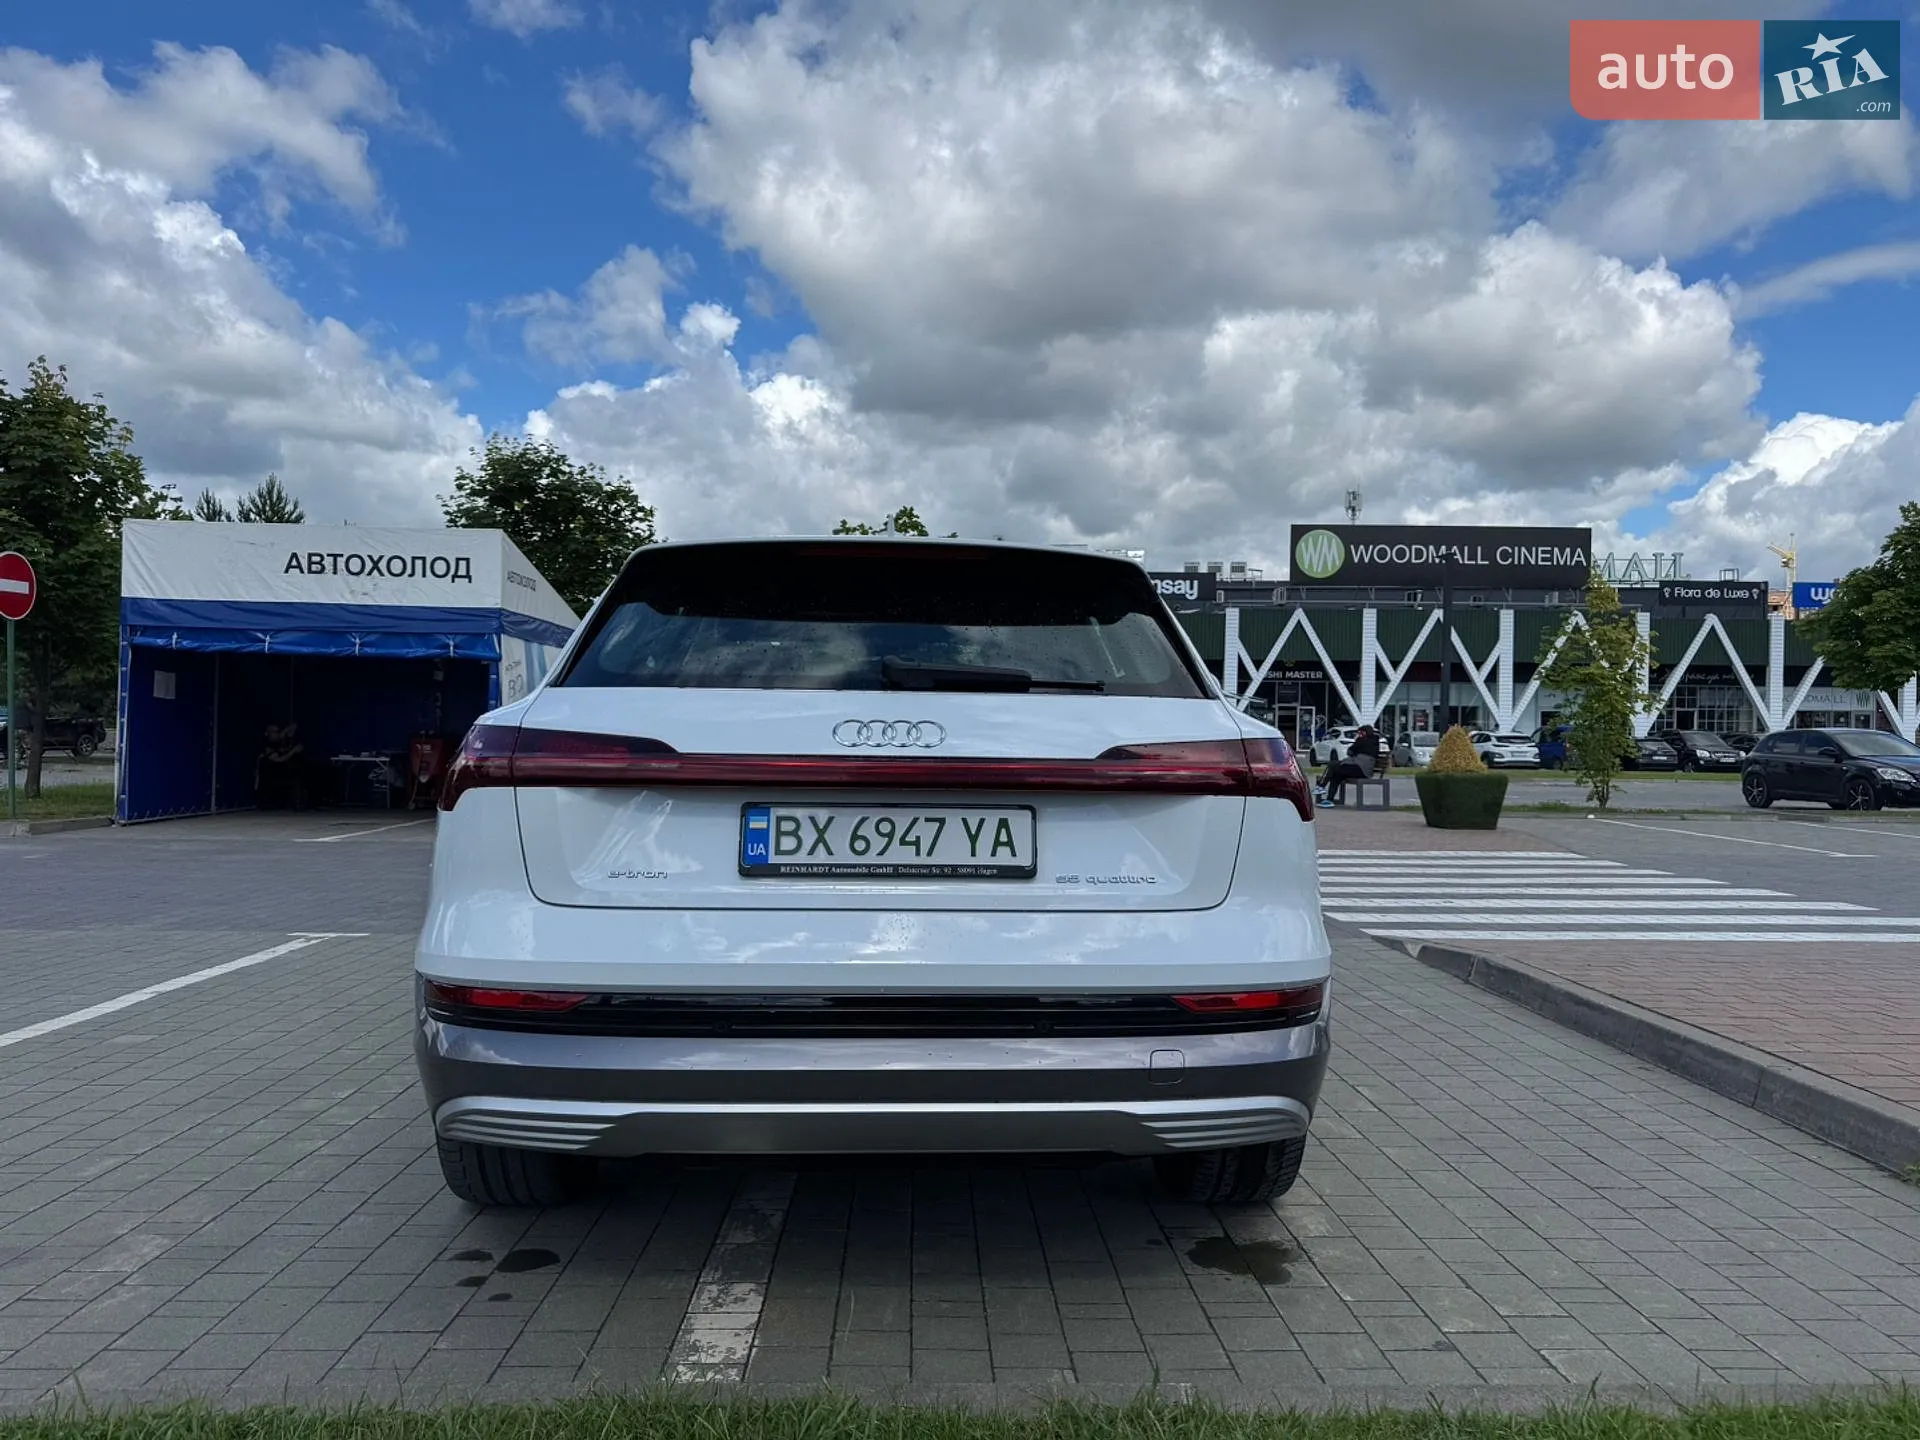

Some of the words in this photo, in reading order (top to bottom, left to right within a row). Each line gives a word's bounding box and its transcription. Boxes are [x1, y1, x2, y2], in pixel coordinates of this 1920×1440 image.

[1350, 543, 1489, 566] WOODMALL
[1496, 545, 1587, 567] CINEMA
[283, 551, 473, 584] АВТОХОЛОД
[1674, 587, 1702, 599] Flora
[1704, 587, 1722, 599] de
[1724, 587, 1750, 599] Luxe
[1285, 670, 1324, 679] MASTER
[774, 815, 836, 857] BX
[848, 816, 947, 857] 6947
[960, 816, 1018, 858] YA
[747, 842, 767, 857] UA
[608, 867, 668, 879] e-tron
[780, 865, 829, 873] REINHARDT
[1085, 873, 1158, 885] quattro
